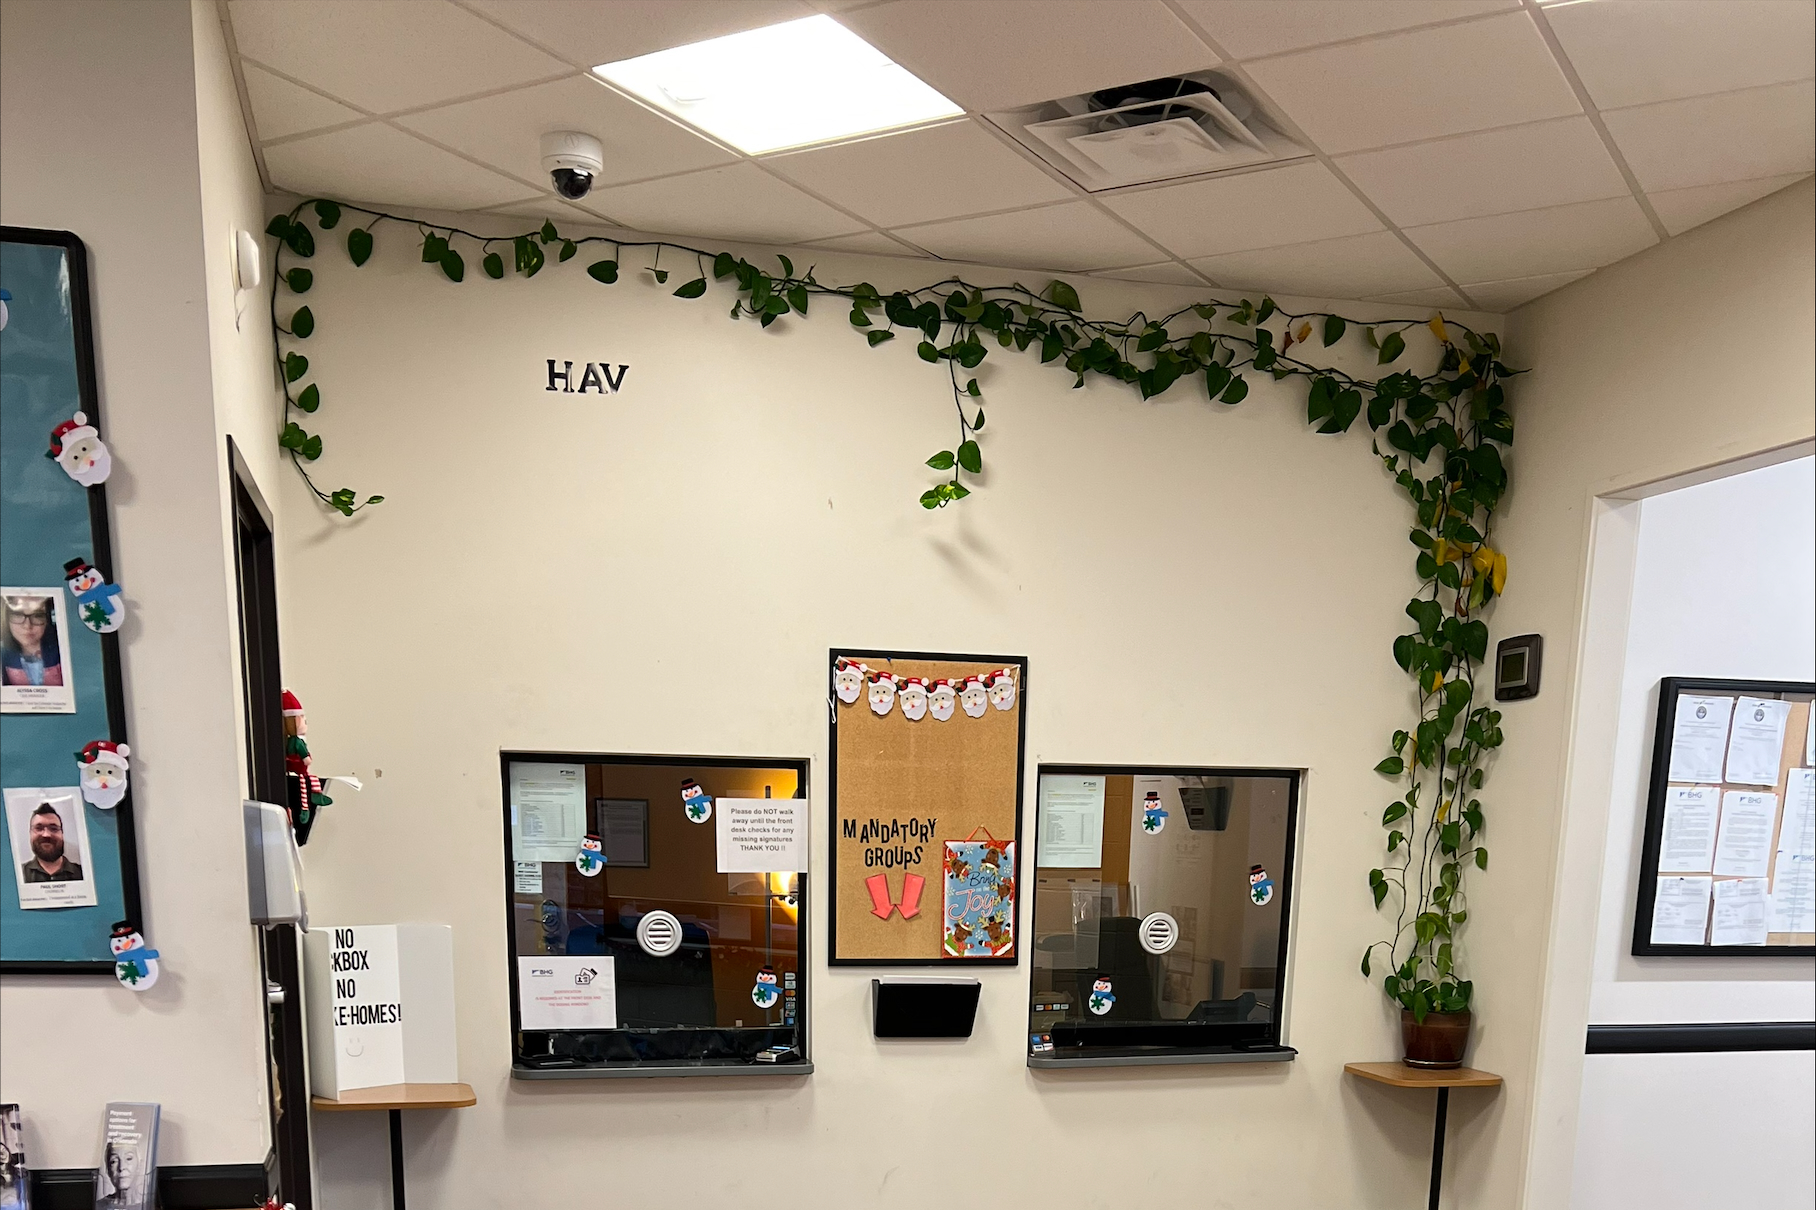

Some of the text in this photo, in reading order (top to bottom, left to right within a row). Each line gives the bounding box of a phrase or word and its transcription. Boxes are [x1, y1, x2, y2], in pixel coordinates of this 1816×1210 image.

[545, 359, 629, 394] HAV
[1747, 796, 1762, 804] BHG
[843, 818, 937, 843] MANDATORY
[864, 846, 924, 870] GROUPS
[947, 888, 994, 920] Joy
[335, 928, 354, 949] NO
[331, 950, 369, 972] KBOX
[336, 978, 356, 999] NO
